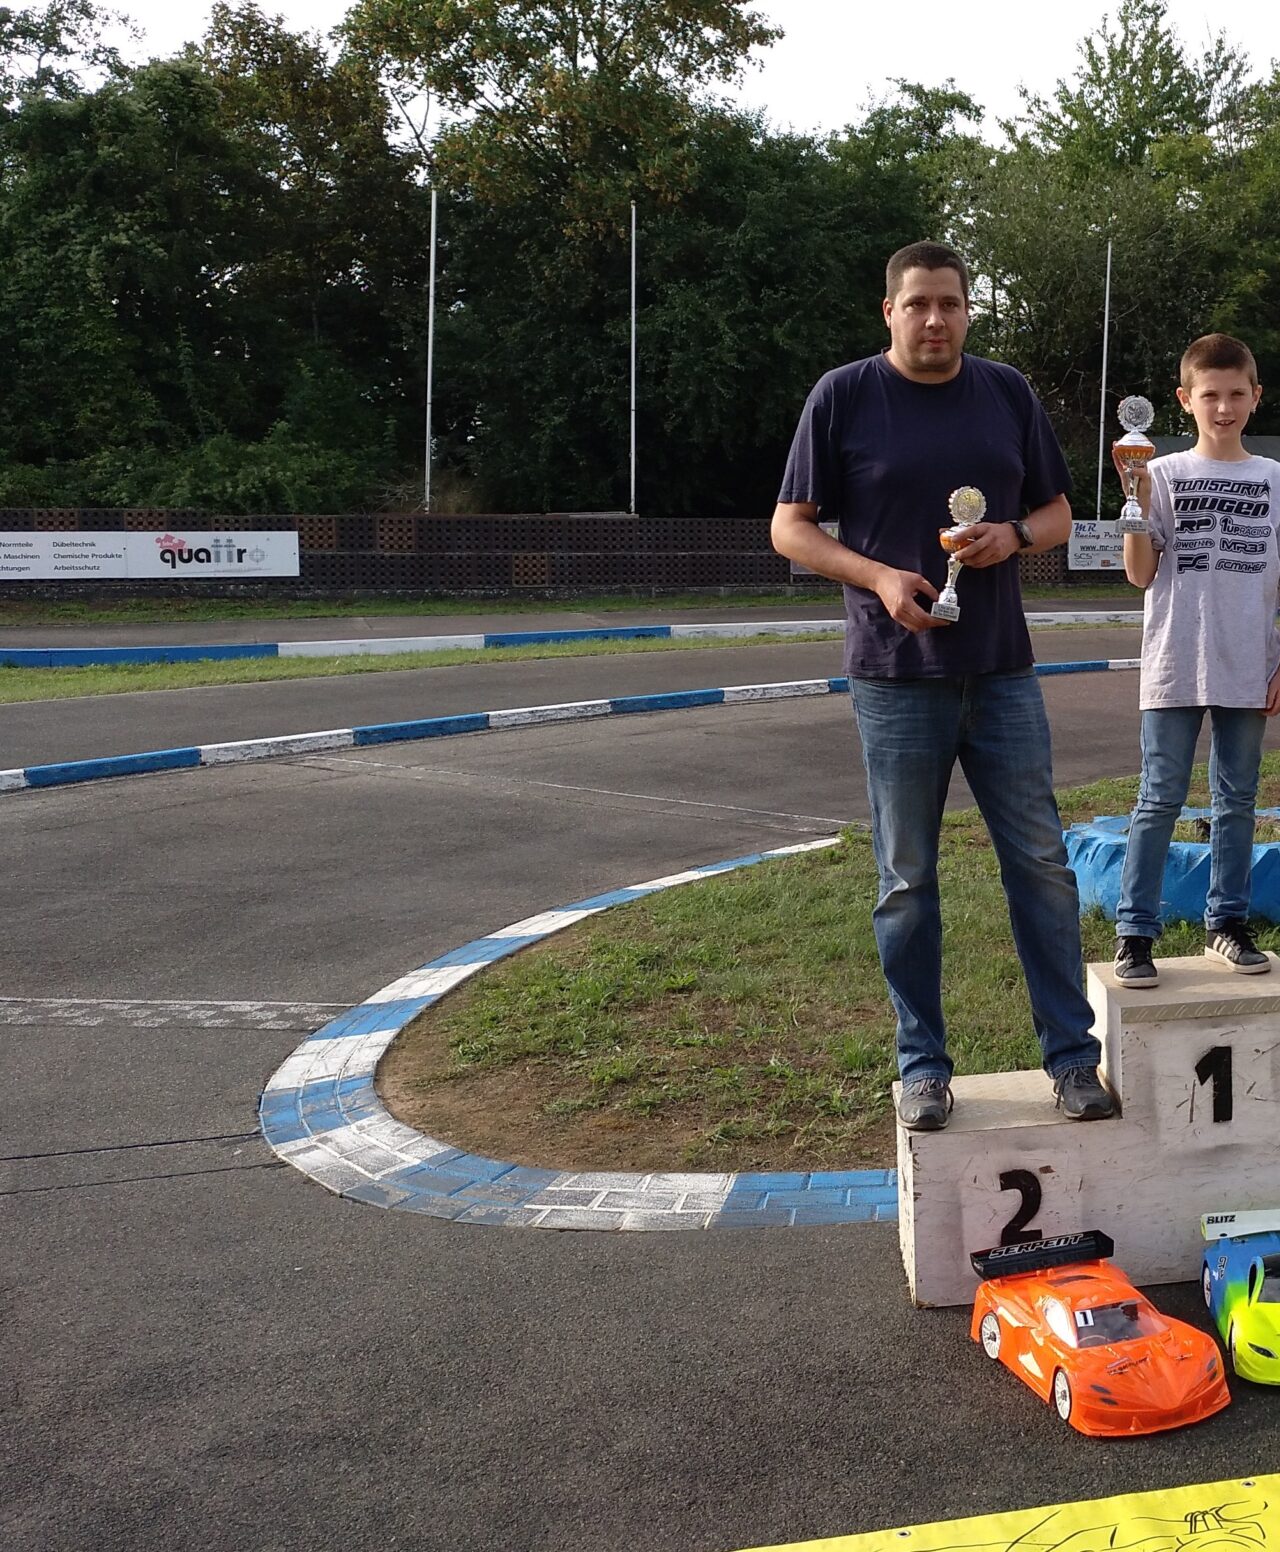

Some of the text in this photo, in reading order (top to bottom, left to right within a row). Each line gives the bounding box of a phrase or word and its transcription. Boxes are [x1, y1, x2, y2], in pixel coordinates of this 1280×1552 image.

[1074, 522, 1097, 532] MR
[1195, 1046, 1232, 1123] 1
[999, 1169, 1042, 1243] 2
[1206, 1215, 1236, 1224] BLITZ
[988, 1234, 1083, 1259] SERPENT
[1079, 1311, 1089, 1325] 1
